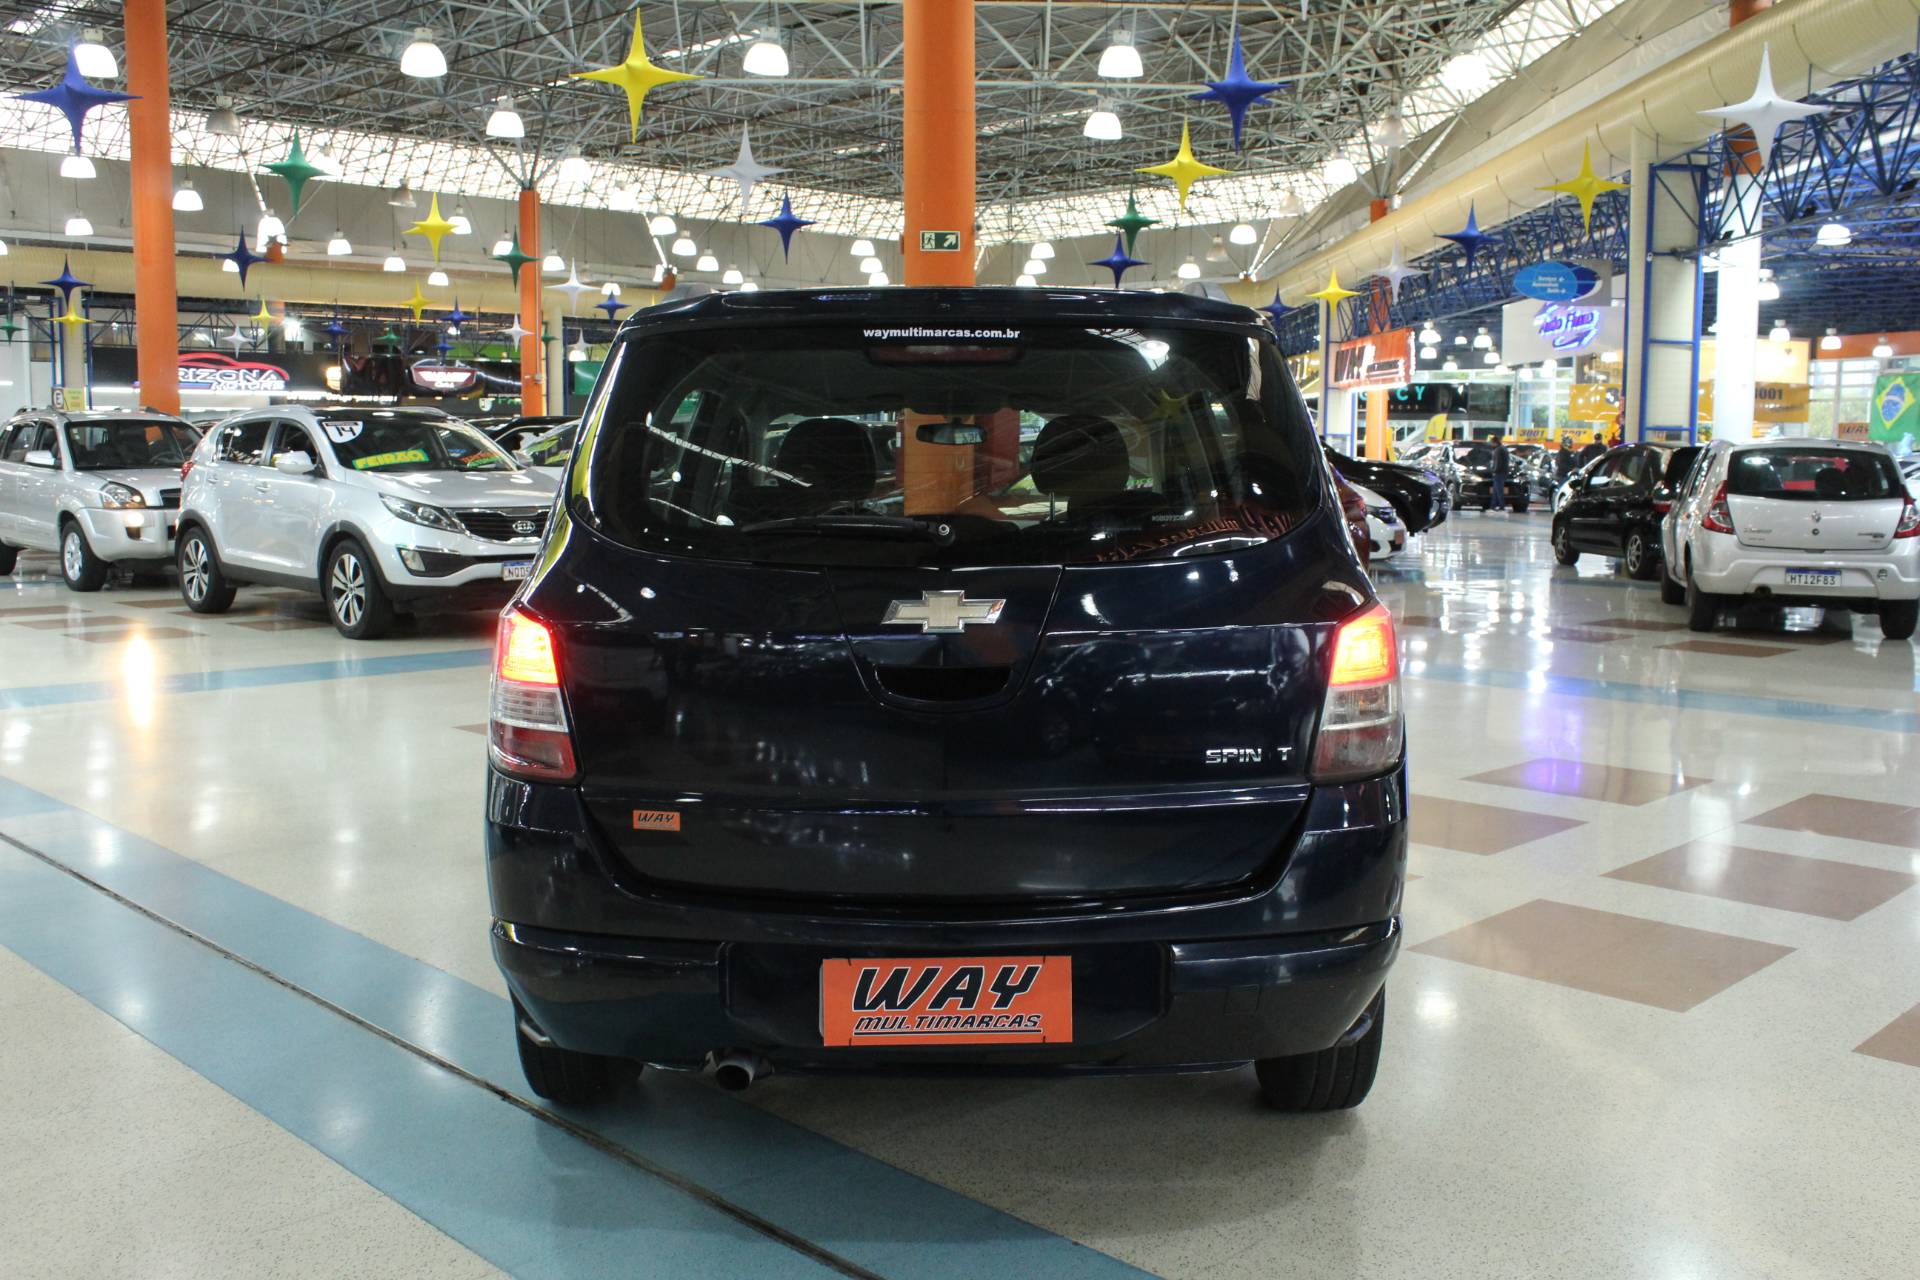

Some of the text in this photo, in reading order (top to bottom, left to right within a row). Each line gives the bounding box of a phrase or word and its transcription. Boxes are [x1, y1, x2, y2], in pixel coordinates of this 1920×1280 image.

[863, 327, 1021, 340] waymultimarcas.com.br
[178, 367, 278, 382] RIZONA
[210, 380, 286, 392] MOTORS
[1755, 387, 1783, 400] 001
[335, 426, 357, 437] 14
[1205, 747, 1262, 763] SPIN
[637, 812, 675, 823] WAY
[852, 964, 1042, 1012] WAY
[854, 1014, 1044, 1031] MULTIMARCAS
